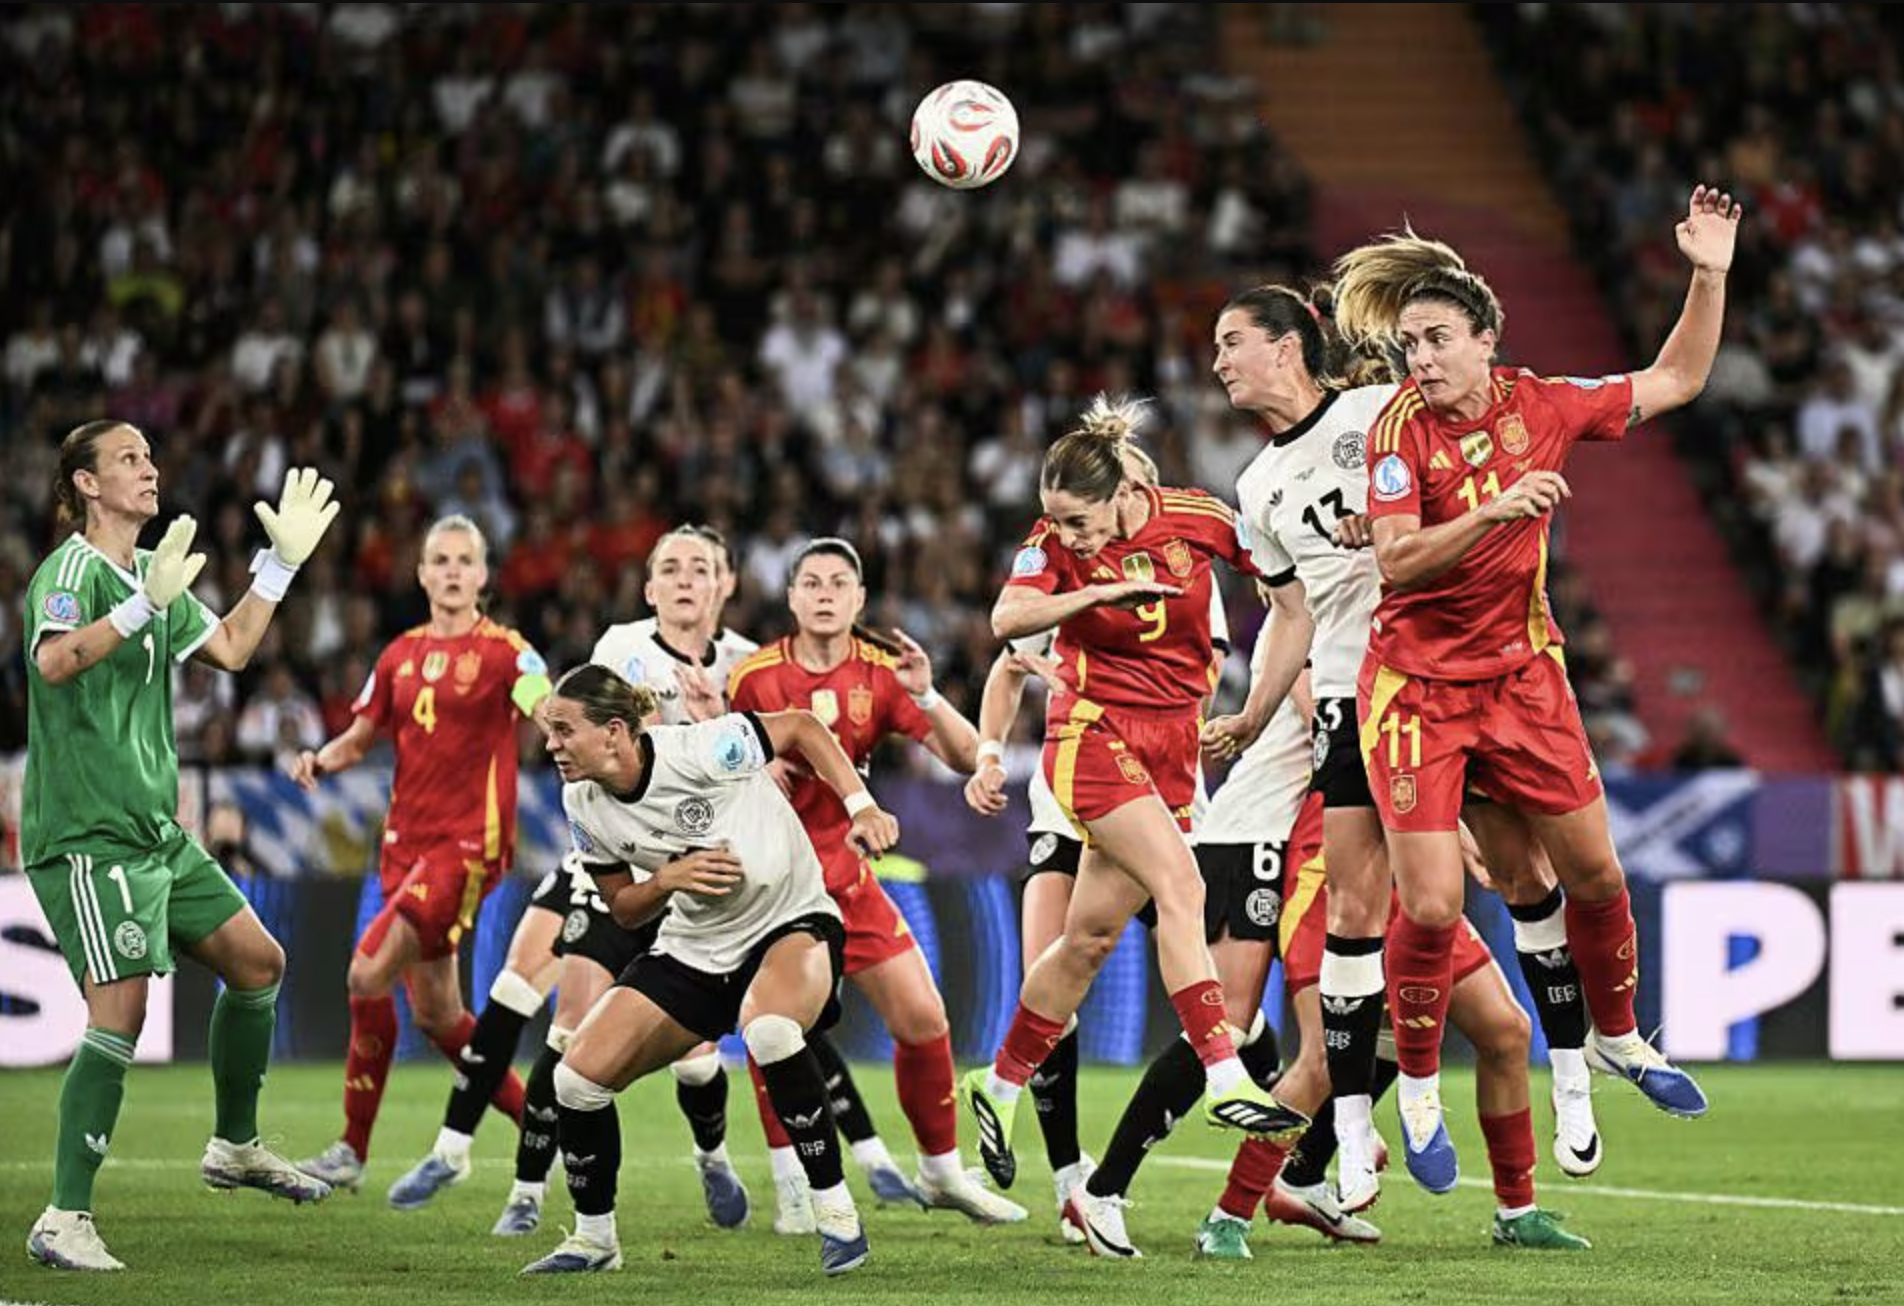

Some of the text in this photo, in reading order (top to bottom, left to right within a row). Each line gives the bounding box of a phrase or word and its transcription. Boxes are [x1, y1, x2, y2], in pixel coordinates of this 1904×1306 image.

[1135, 594, 1167, 643] 9
[143, 633, 155, 685] 1
[412, 685, 437, 735] 4
[1381, 711, 1422, 768] 11
[1252, 840, 1282, 881] 6
[107, 865, 133, 914] 1
